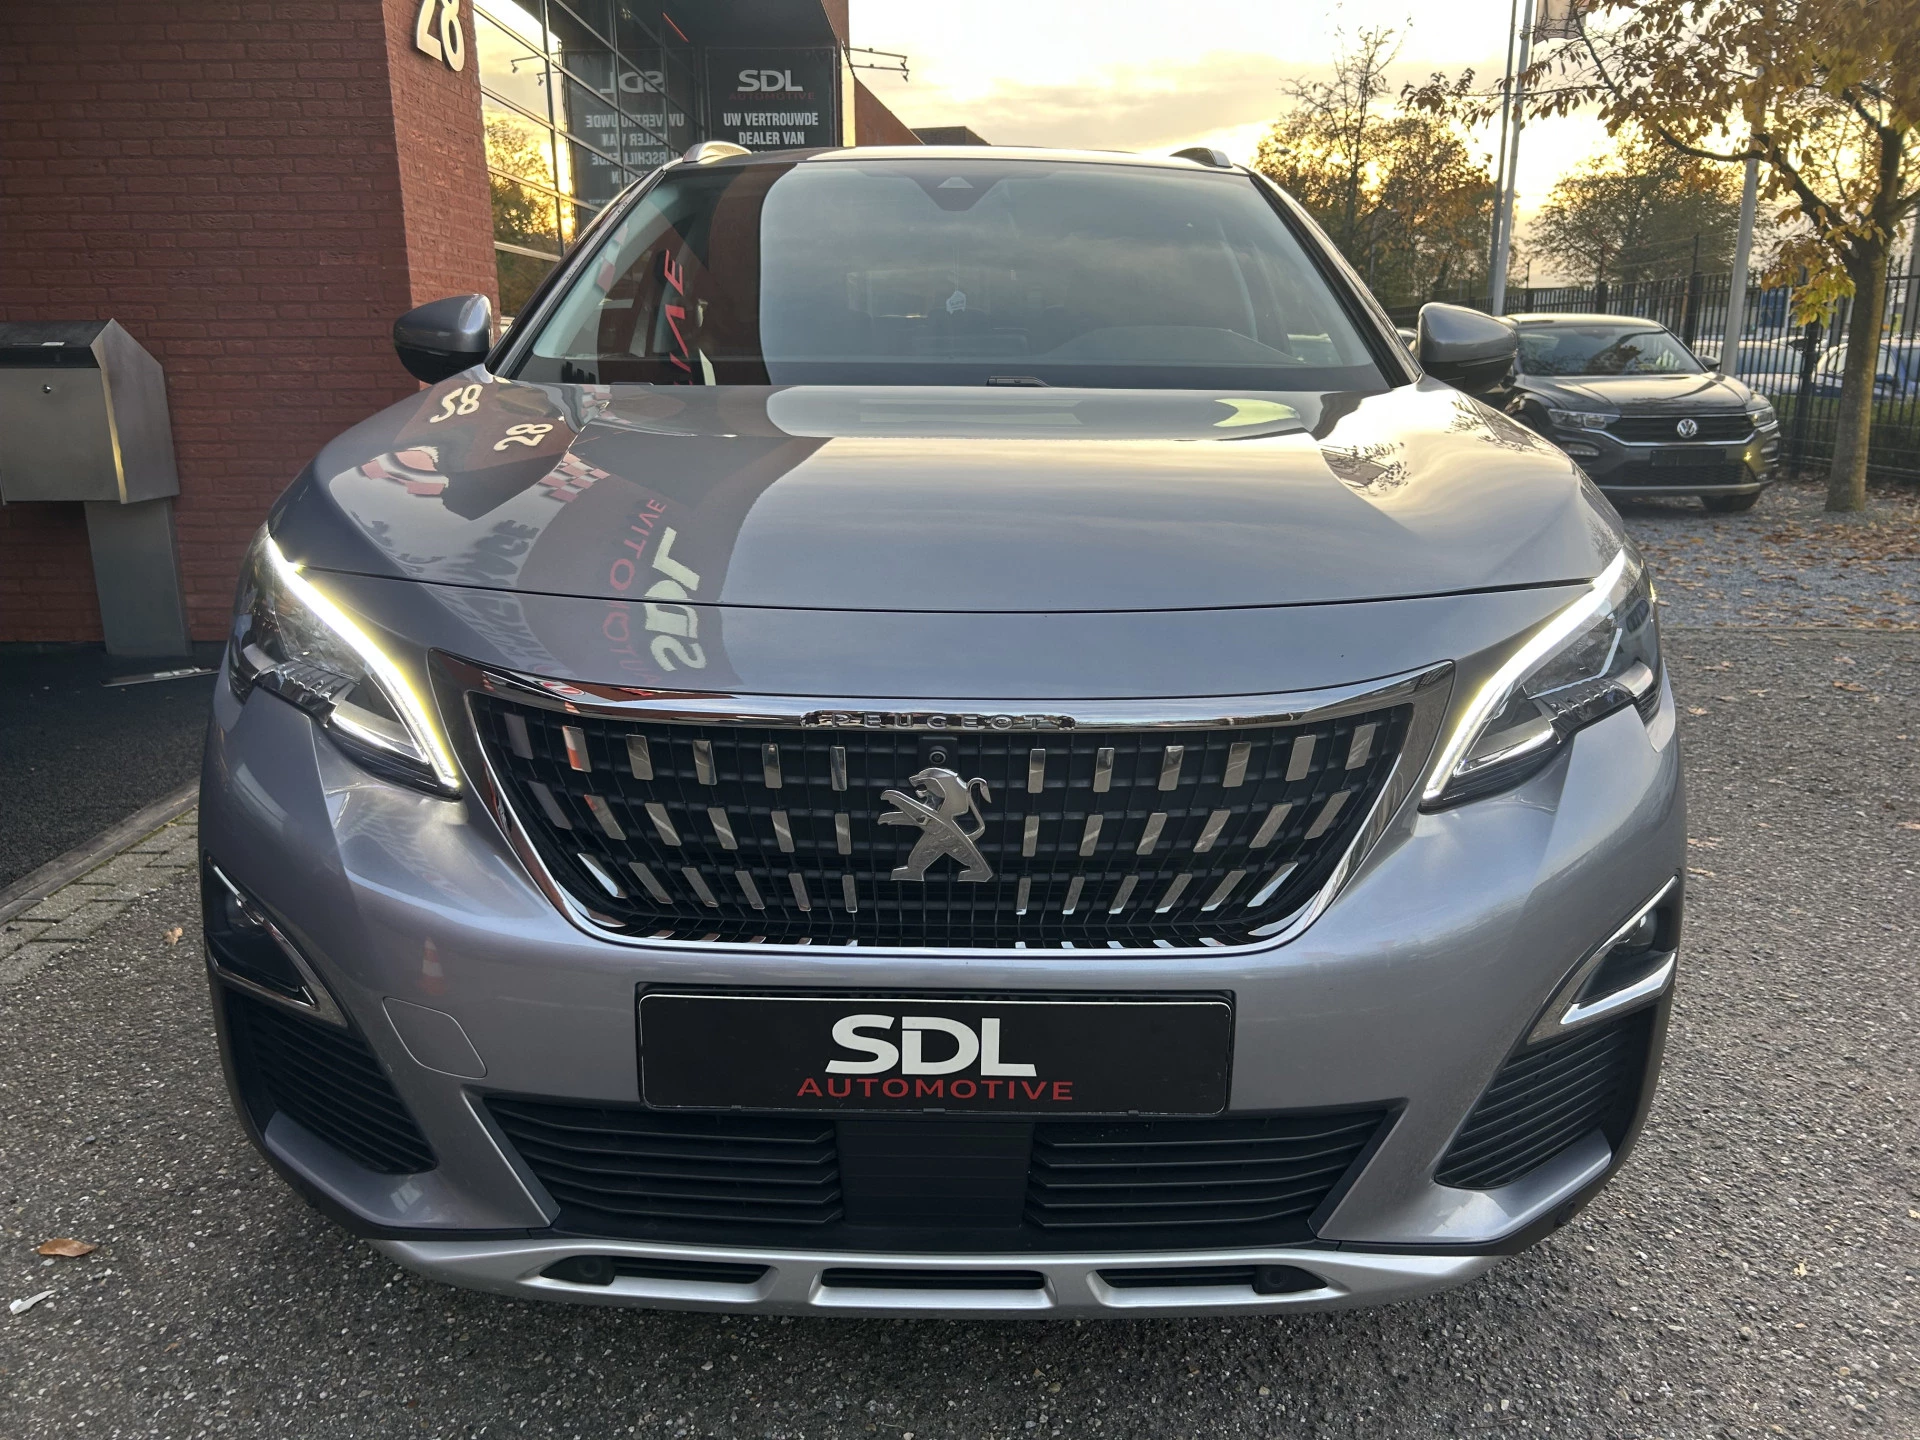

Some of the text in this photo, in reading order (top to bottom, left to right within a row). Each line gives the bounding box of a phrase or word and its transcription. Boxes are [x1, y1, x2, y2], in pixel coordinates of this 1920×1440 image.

[416, 0, 465, 72] 28
[737, 69, 804, 92] SDL
[728, 91, 816, 101] AUTOMOTIVE
[723, 112, 819, 127] UW VERTROUWDE
[738, 131, 805, 145] DEALER VAN
[831, 712, 1046, 731] PEUGEOT
[825, 1013, 1037, 1077] SDL
[797, 1077, 1073, 1101] AUTOMOTIVE
